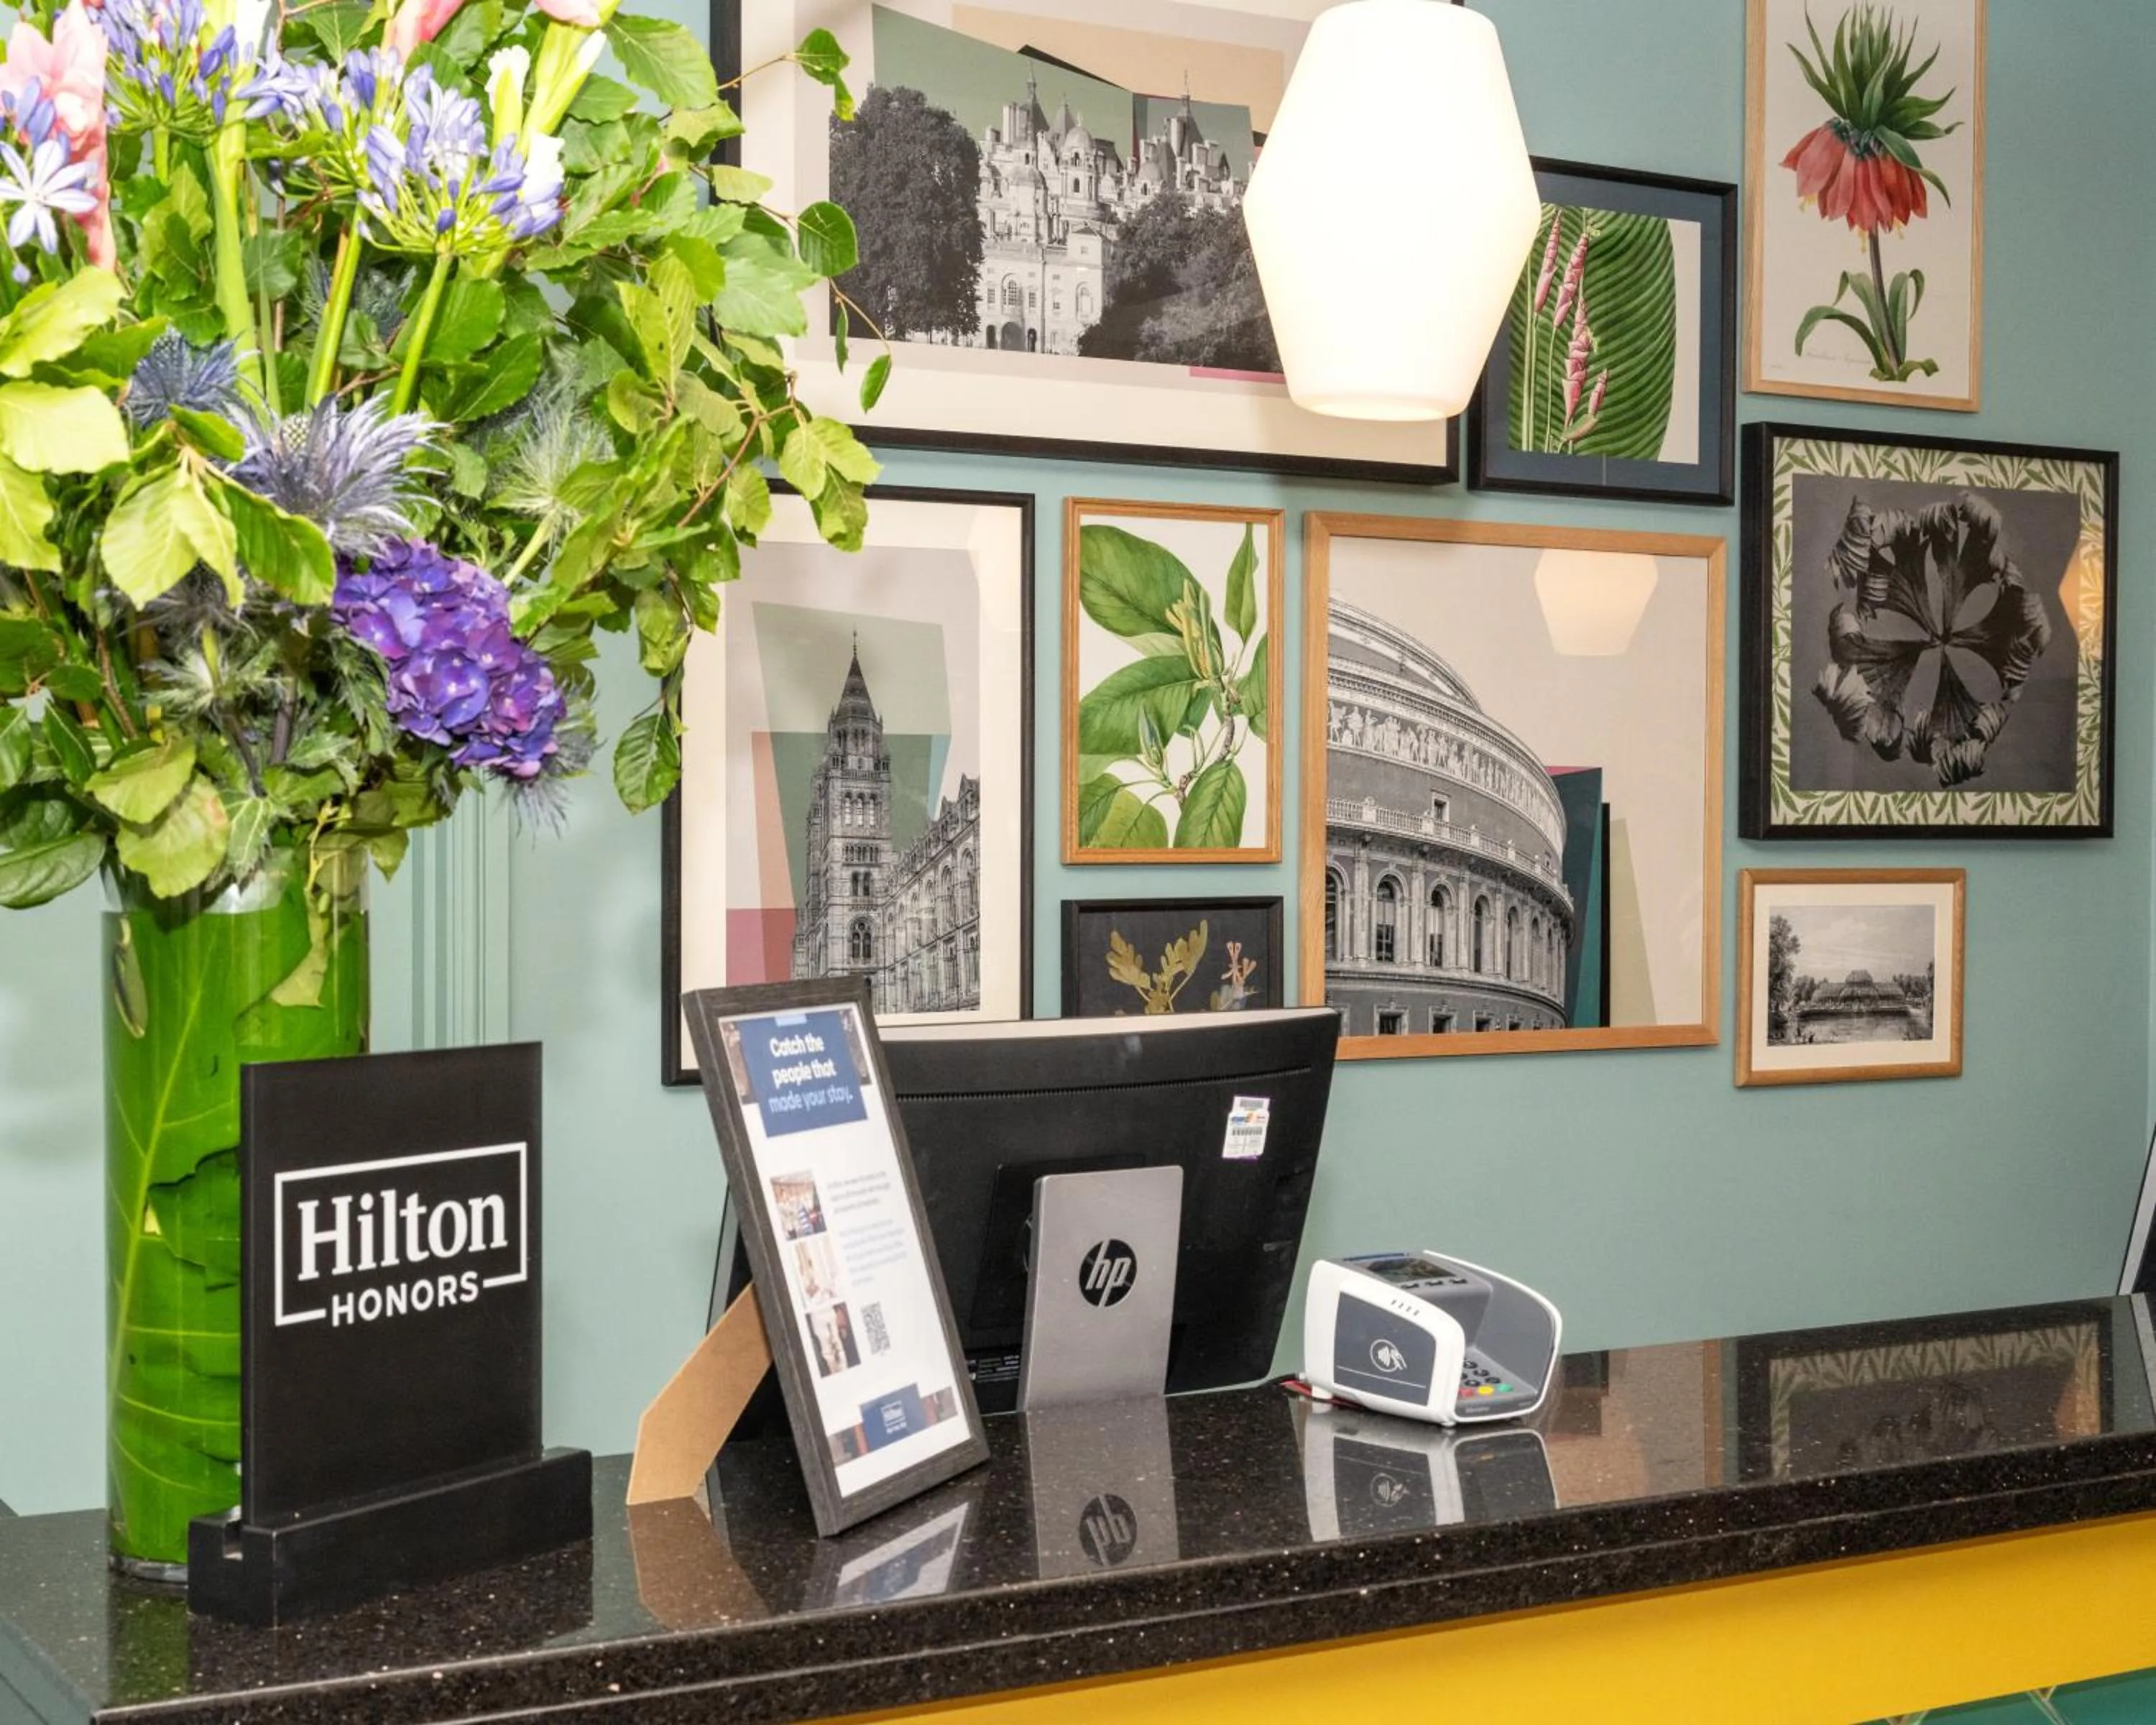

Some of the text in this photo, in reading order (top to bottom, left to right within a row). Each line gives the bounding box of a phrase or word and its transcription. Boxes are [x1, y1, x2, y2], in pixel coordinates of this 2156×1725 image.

[770, 1032, 825, 1058] Catch the
[772, 1058, 837, 1089] people that
[768, 1090, 802, 1113] made
[801, 1090, 826, 1111] your
[298, 1188, 508, 1282] Hilton
[1084, 1240, 1132, 1308] hp
[331, 1270, 479, 1328] HONORS
